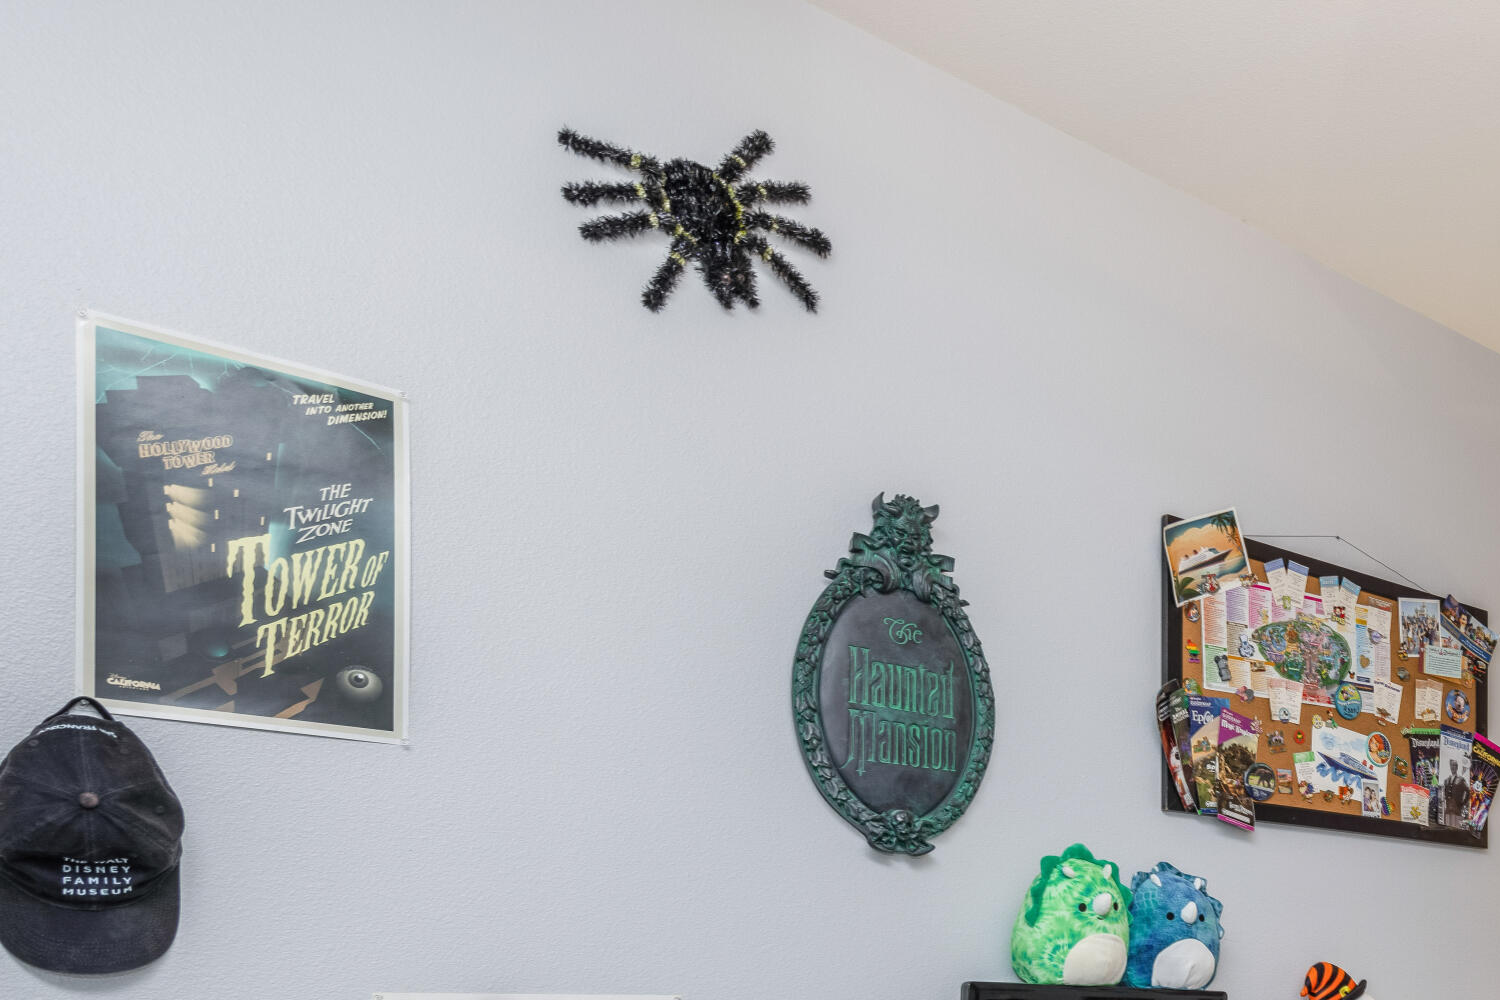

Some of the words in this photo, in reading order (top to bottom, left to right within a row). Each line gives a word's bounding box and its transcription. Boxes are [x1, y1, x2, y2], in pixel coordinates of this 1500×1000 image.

[292, 394, 335, 405] TRAVEL
[305, 405, 332, 416] INTO
[335, 402, 374, 413] ANOTHER
[327, 410, 388, 426] DIMENSION!
[138, 434, 233, 458] HOLLYWOOD
[162, 450, 216, 470] TOWER
[320, 483, 352, 501] THE
[283, 498, 374, 531] TWILIGHT
[295, 518, 354, 544] ZONE
[226, 533, 366, 628] TOWER
[360, 550, 390, 589] OF
[255, 590, 376, 679] TERROR
[883, 617, 924, 645] The
[848, 645, 955, 720] Haunted
[839, 708, 957, 776] Mansion
[62, 864, 131, 873] DISNEY
[62, 876, 132, 885] FAMILY
[62, 885, 133, 896] MUSEUM
